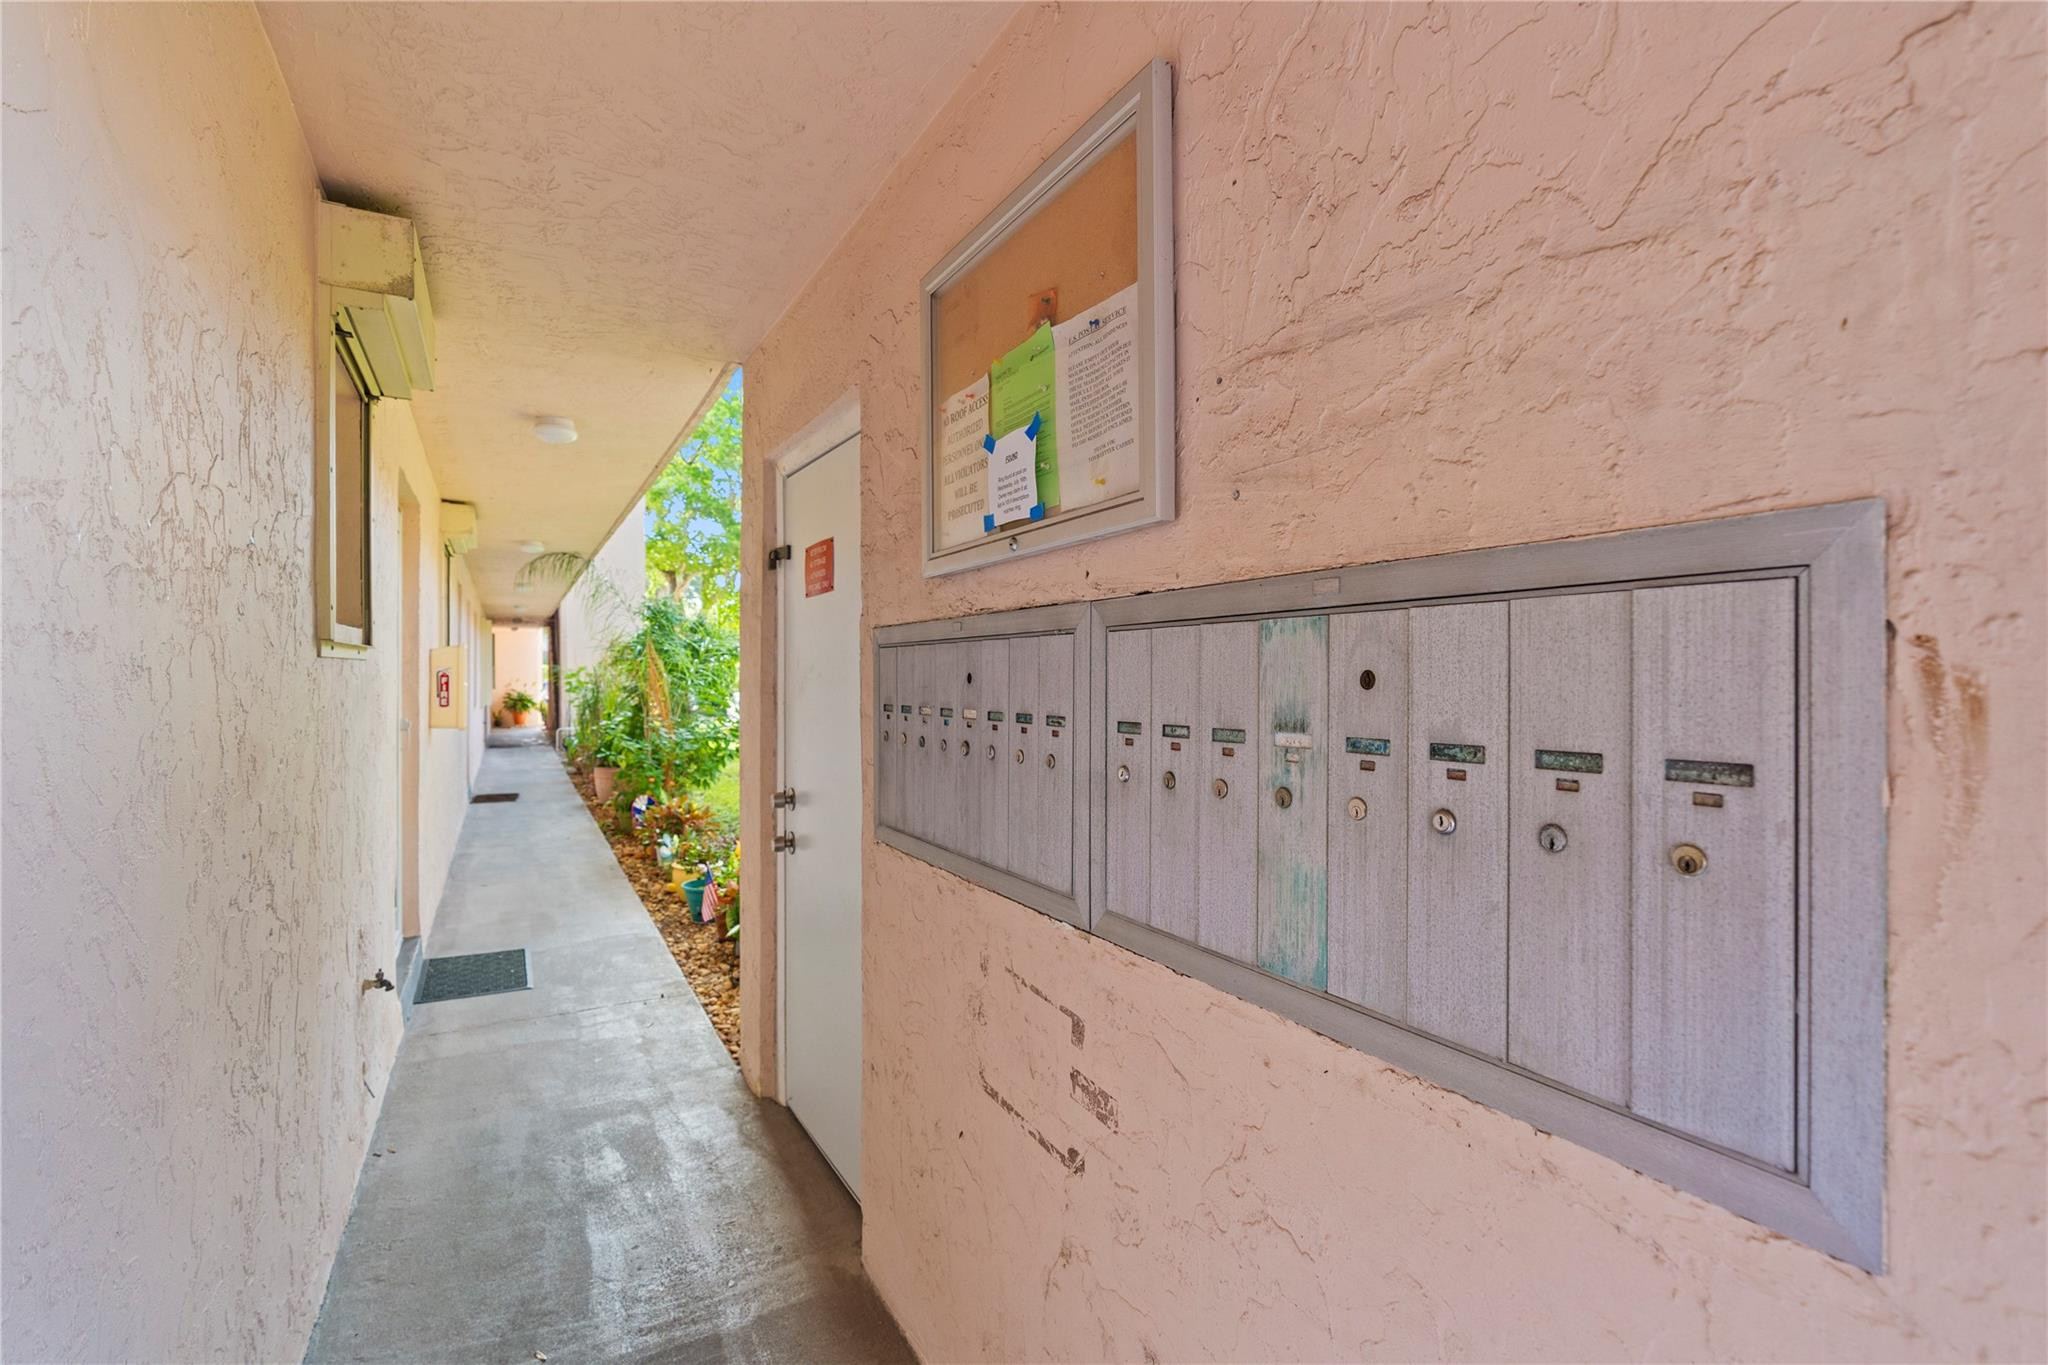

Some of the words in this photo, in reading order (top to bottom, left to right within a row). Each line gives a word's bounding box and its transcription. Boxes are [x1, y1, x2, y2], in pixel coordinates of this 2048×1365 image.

[1101, 306, 1127, 325] SERVICE
[950, 406, 967, 423] ROOF
[969, 394, 988, 413] ACCESS
[947, 419, 983, 445] AUTHORIZED
[942, 444, 972, 466] PERSONNEL
[974, 439, 983, 452] ON
[944, 473, 954, 485] ALL
[954, 458, 988, 480] VIOLATORS
[954, 486, 967, 499] WILL
[969, 482, 977, 494] BE
[947, 499, 984, 520] PROSECUTED
